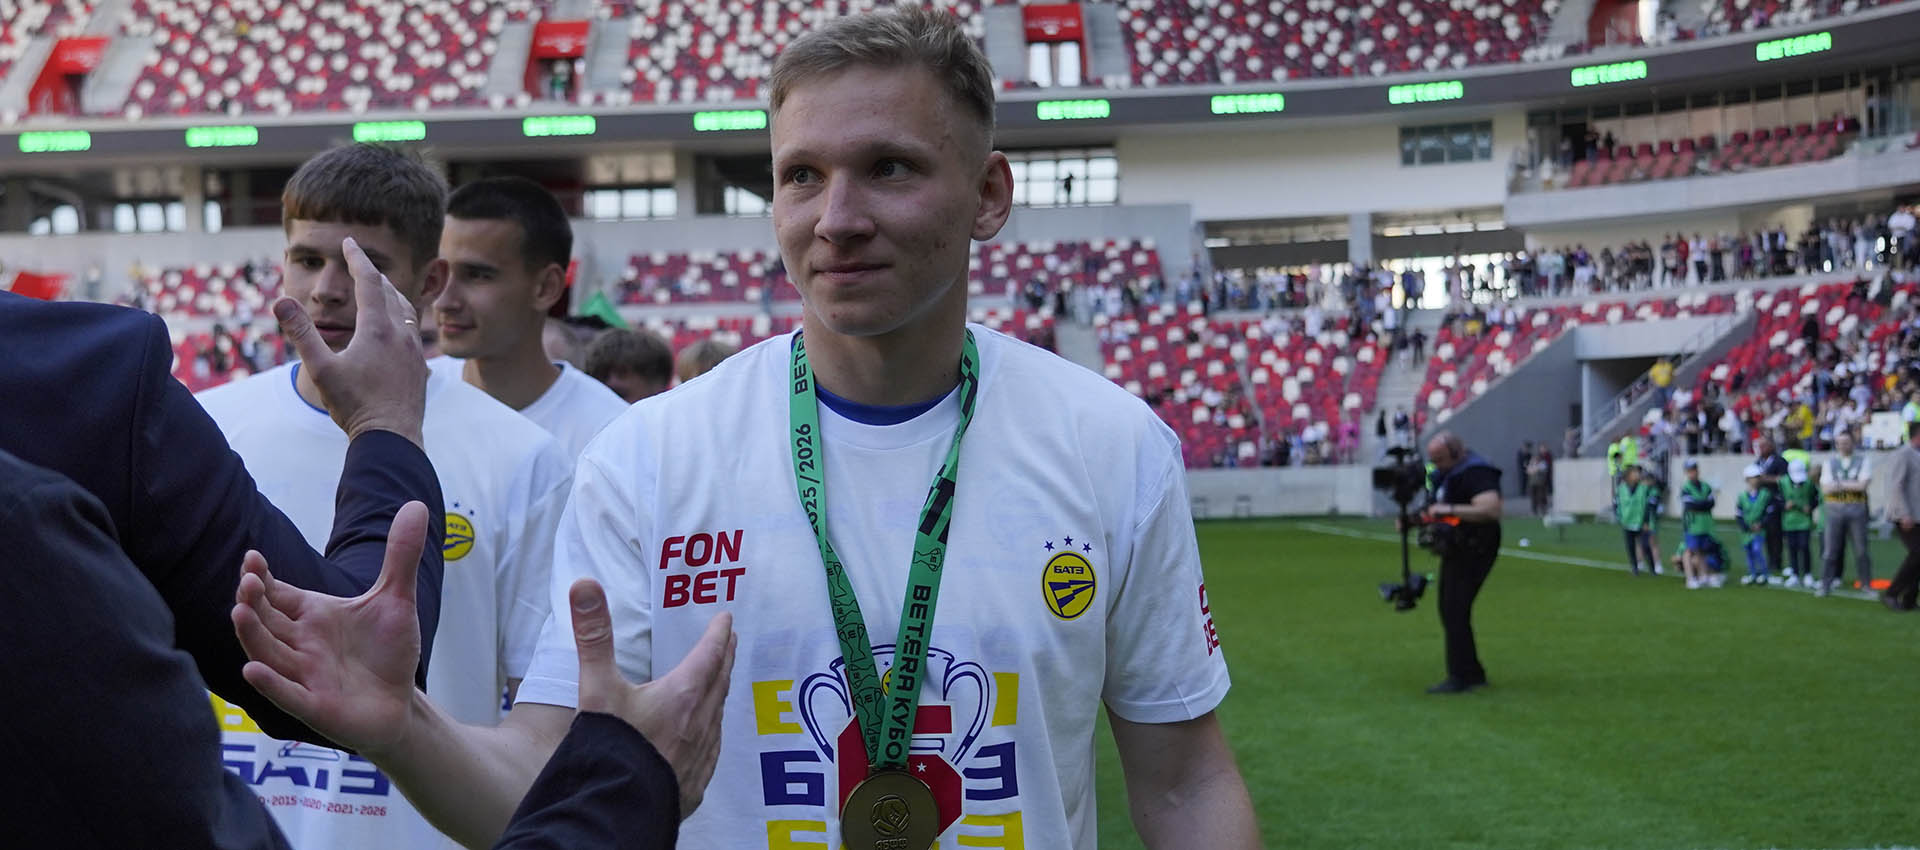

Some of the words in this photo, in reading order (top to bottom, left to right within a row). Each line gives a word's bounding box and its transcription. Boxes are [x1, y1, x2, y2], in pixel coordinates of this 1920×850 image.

[794, 335, 808, 395] BETE
[659, 529, 744, 570] FON
[1053, 565, 1085, 575] БАТЭ
[663, 567, 746, 608] BET
